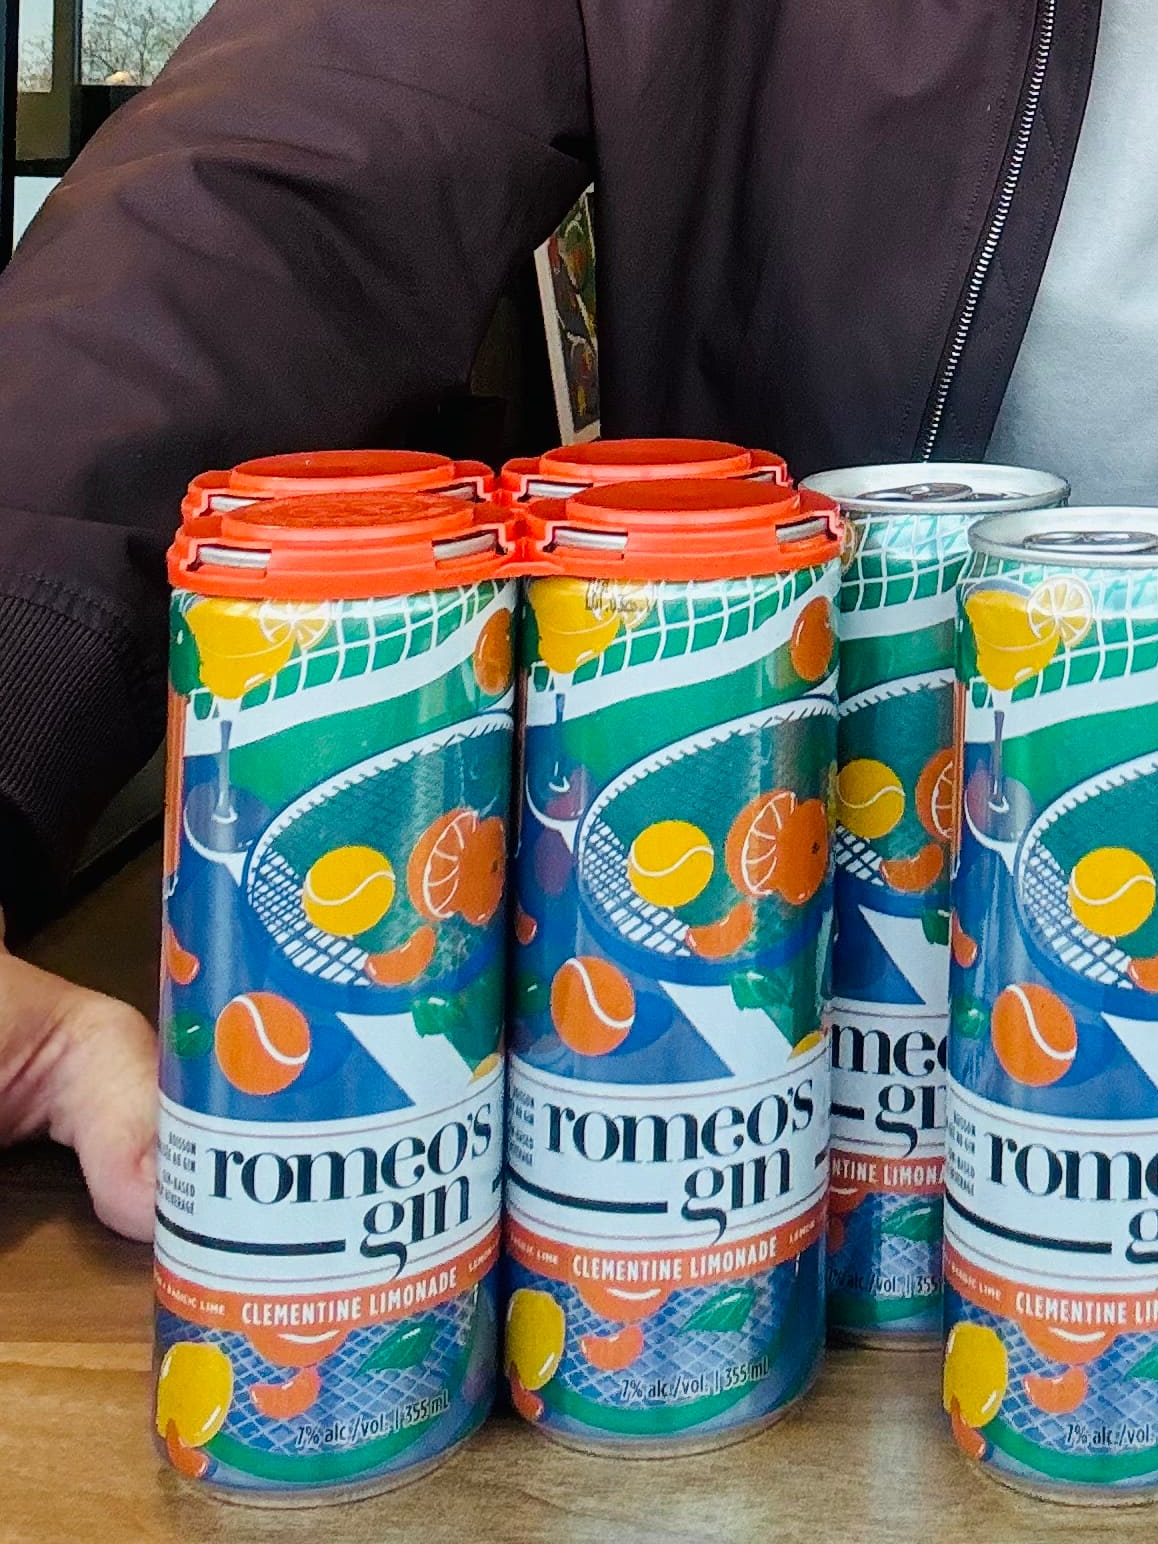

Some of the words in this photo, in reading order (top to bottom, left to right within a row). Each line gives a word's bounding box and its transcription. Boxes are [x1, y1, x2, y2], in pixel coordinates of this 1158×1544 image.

[543, 1079, 813, 1163] romeo's
[875, 1084, 945, 1158] gi
[205, 1103, 492, 1204] romeo's
[681, 1148, 791, 1246] gin
[359, 1176, 472, 1282] gin
[572, 1254, 682, 1282] CLEMENTINE
[689, 1235, 778, 1280] LIMONADE
[242, 1299, 361, 1327] CLEMENTINE
[369, 1266, 457, 1315] LIMONADE
[1015, 1290, 1128, 1325] CLEMENTINE
[620, 1378, 642, 1400] 7%
[724, 1367, 748, 1389] 355
[750, 1356, 769, 1382] mL
[294, 1425, 321, 1448] 7%
[403, 1404, 429, 1425] 355
[430, 1391, 449, 1416] mL
[1064, 1423, 1088, 1446] 7%
